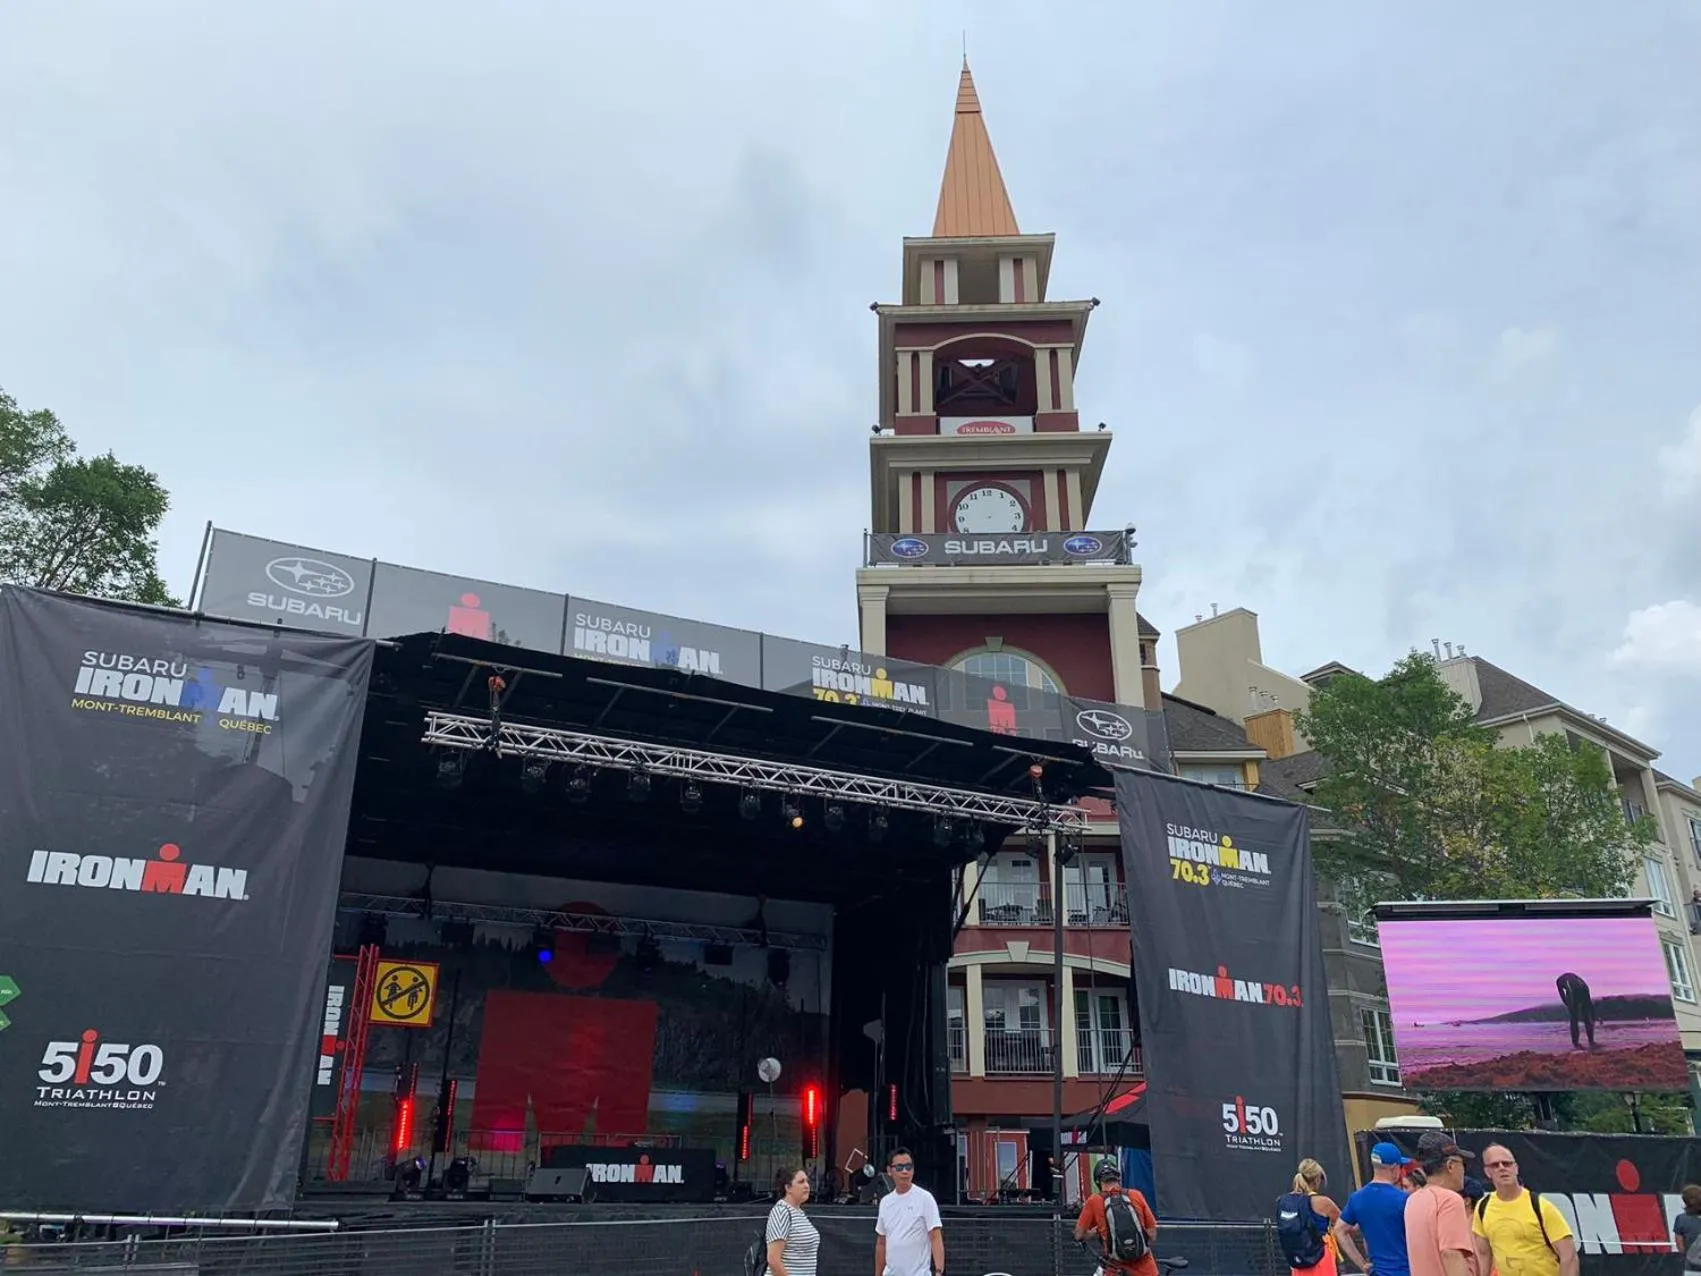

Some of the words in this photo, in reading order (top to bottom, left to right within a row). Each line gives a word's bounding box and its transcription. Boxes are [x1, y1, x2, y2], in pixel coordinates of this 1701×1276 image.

[961, 426, 1012, 434] TREMBLANT
[958, 515, 965, 523] 9
[1011, 524, 1017, 532] 4
[1014, 512, 1021, 520] 3
[945, 539, 1048, 554] SUBARU
[247, 592, 361, 625] SUBARU
[575, 613, 650, 638] SUBARU
[81, 650, 188, 678] SUBARU
[812, 655, 871, 676] SUBARU
[74, 666, 278, 721] IRONMAN
[812, 667, 927, 706] IRONMAN
[813, 687, 857, 705] 703
[71, 698, 201, 724] MONT-TREMBLANT
[1167, 823, 1218, 844] SUBARU
[1167, 835, 1269, 874] IRONMAN
[27, 843, 248, 900] IRONMAN
[1170, 858, 1210, 886] 70.3
[1168, 965, 1264, 1004] IRONMAN
[1263, 983, 1303, 1007] 70.3
[317, 985, 346, 1085] IRONMAN
[36, 1086, 156, 1101] TRIATHLON
[1225, 1134, 1281, 1147] TRIATHLON
